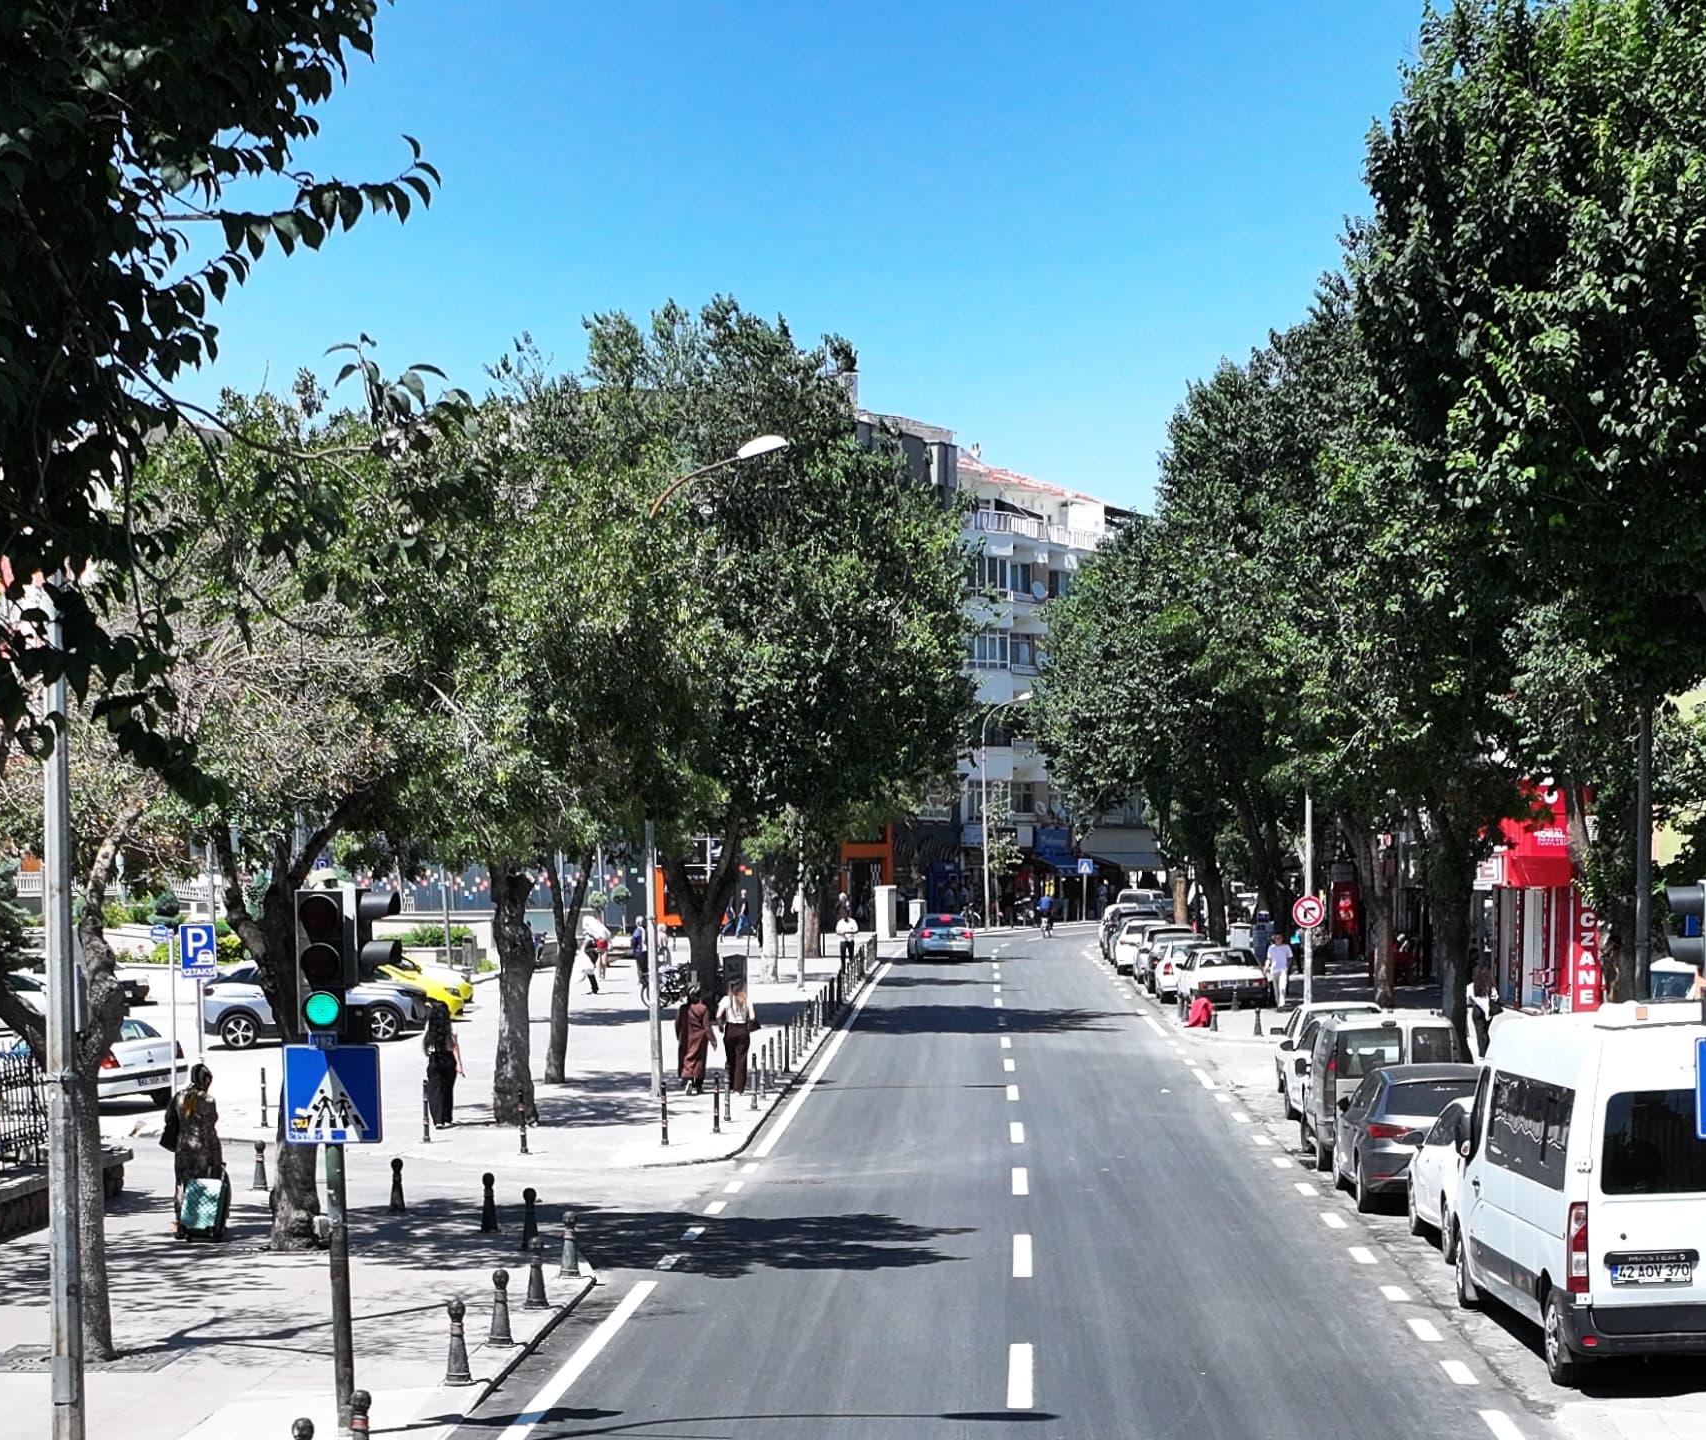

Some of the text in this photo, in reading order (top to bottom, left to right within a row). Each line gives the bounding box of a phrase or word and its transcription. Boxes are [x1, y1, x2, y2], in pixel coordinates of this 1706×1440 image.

[186, 927, 208, 958] P
[315, 1036, 334, 1048] 192
[1618, 1263, 1690, 1279] 42 AOV 370
